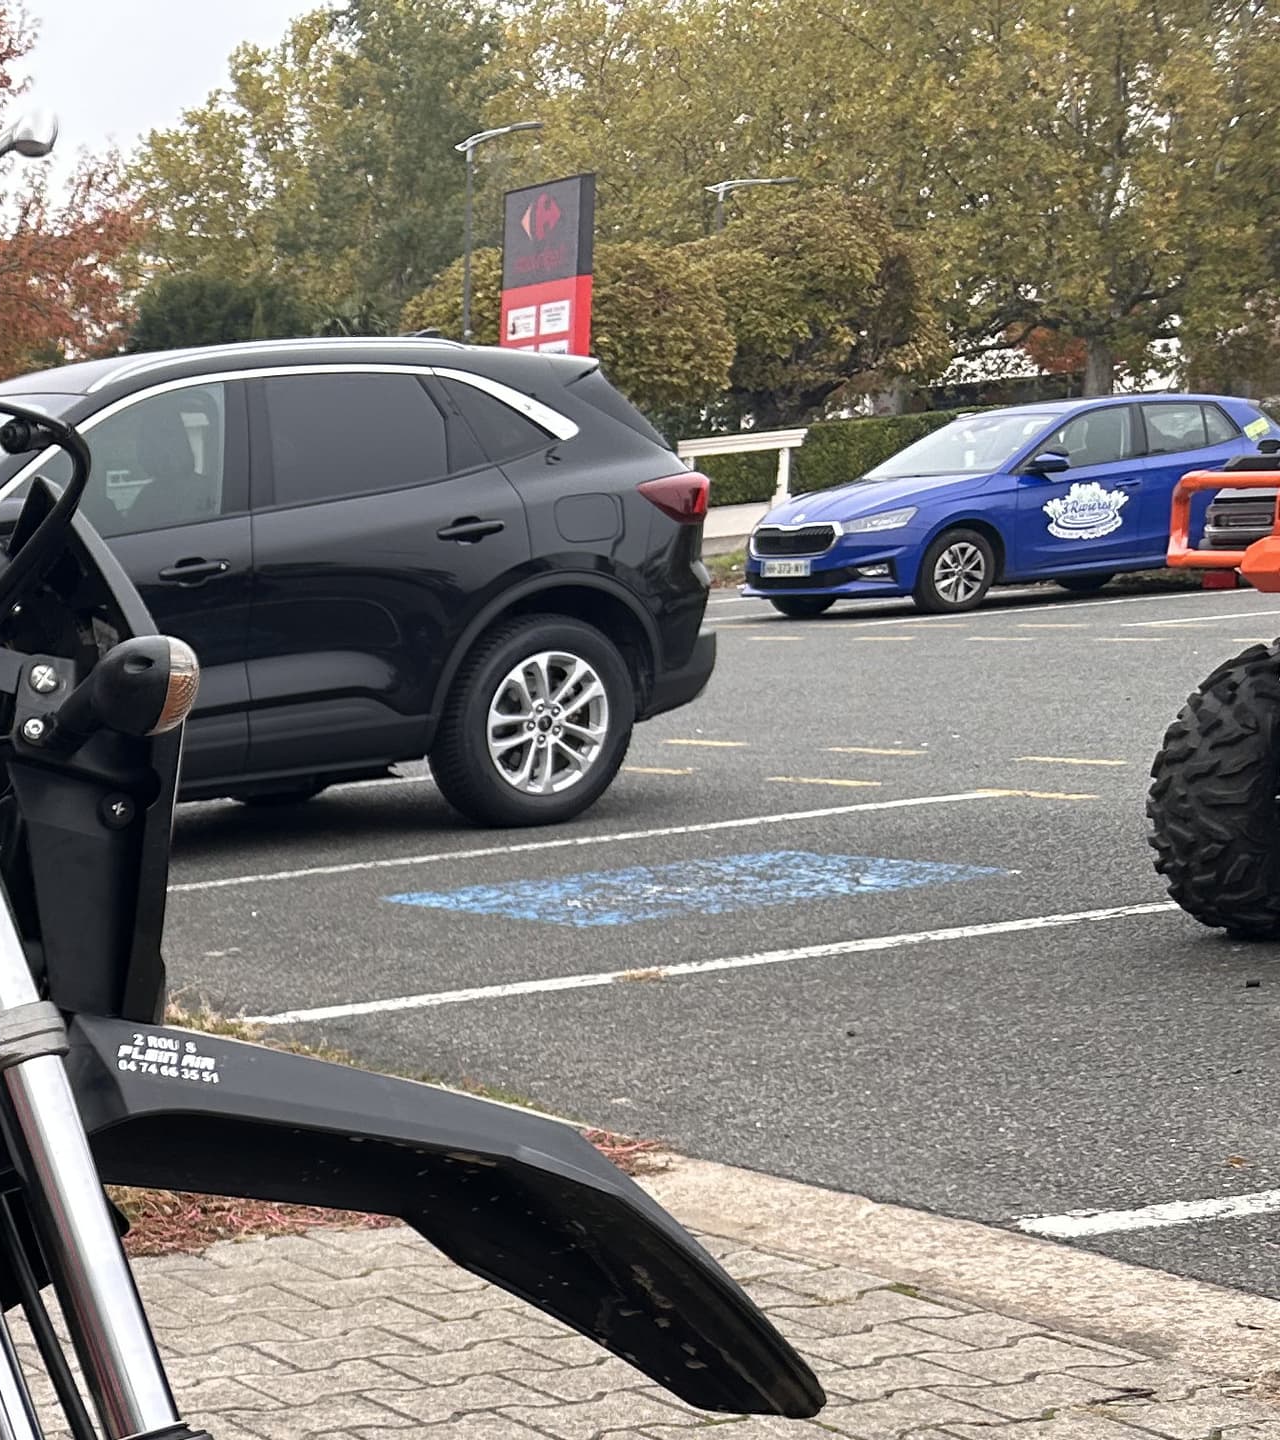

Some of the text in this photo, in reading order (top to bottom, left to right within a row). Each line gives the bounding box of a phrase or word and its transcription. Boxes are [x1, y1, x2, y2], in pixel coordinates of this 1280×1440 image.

[132, 1033, 145, 1046] 2
[117, 1044, 216, 1071] PLEIN AIR
[118, 1059, 220, 1084] 04 74 66 35 51
